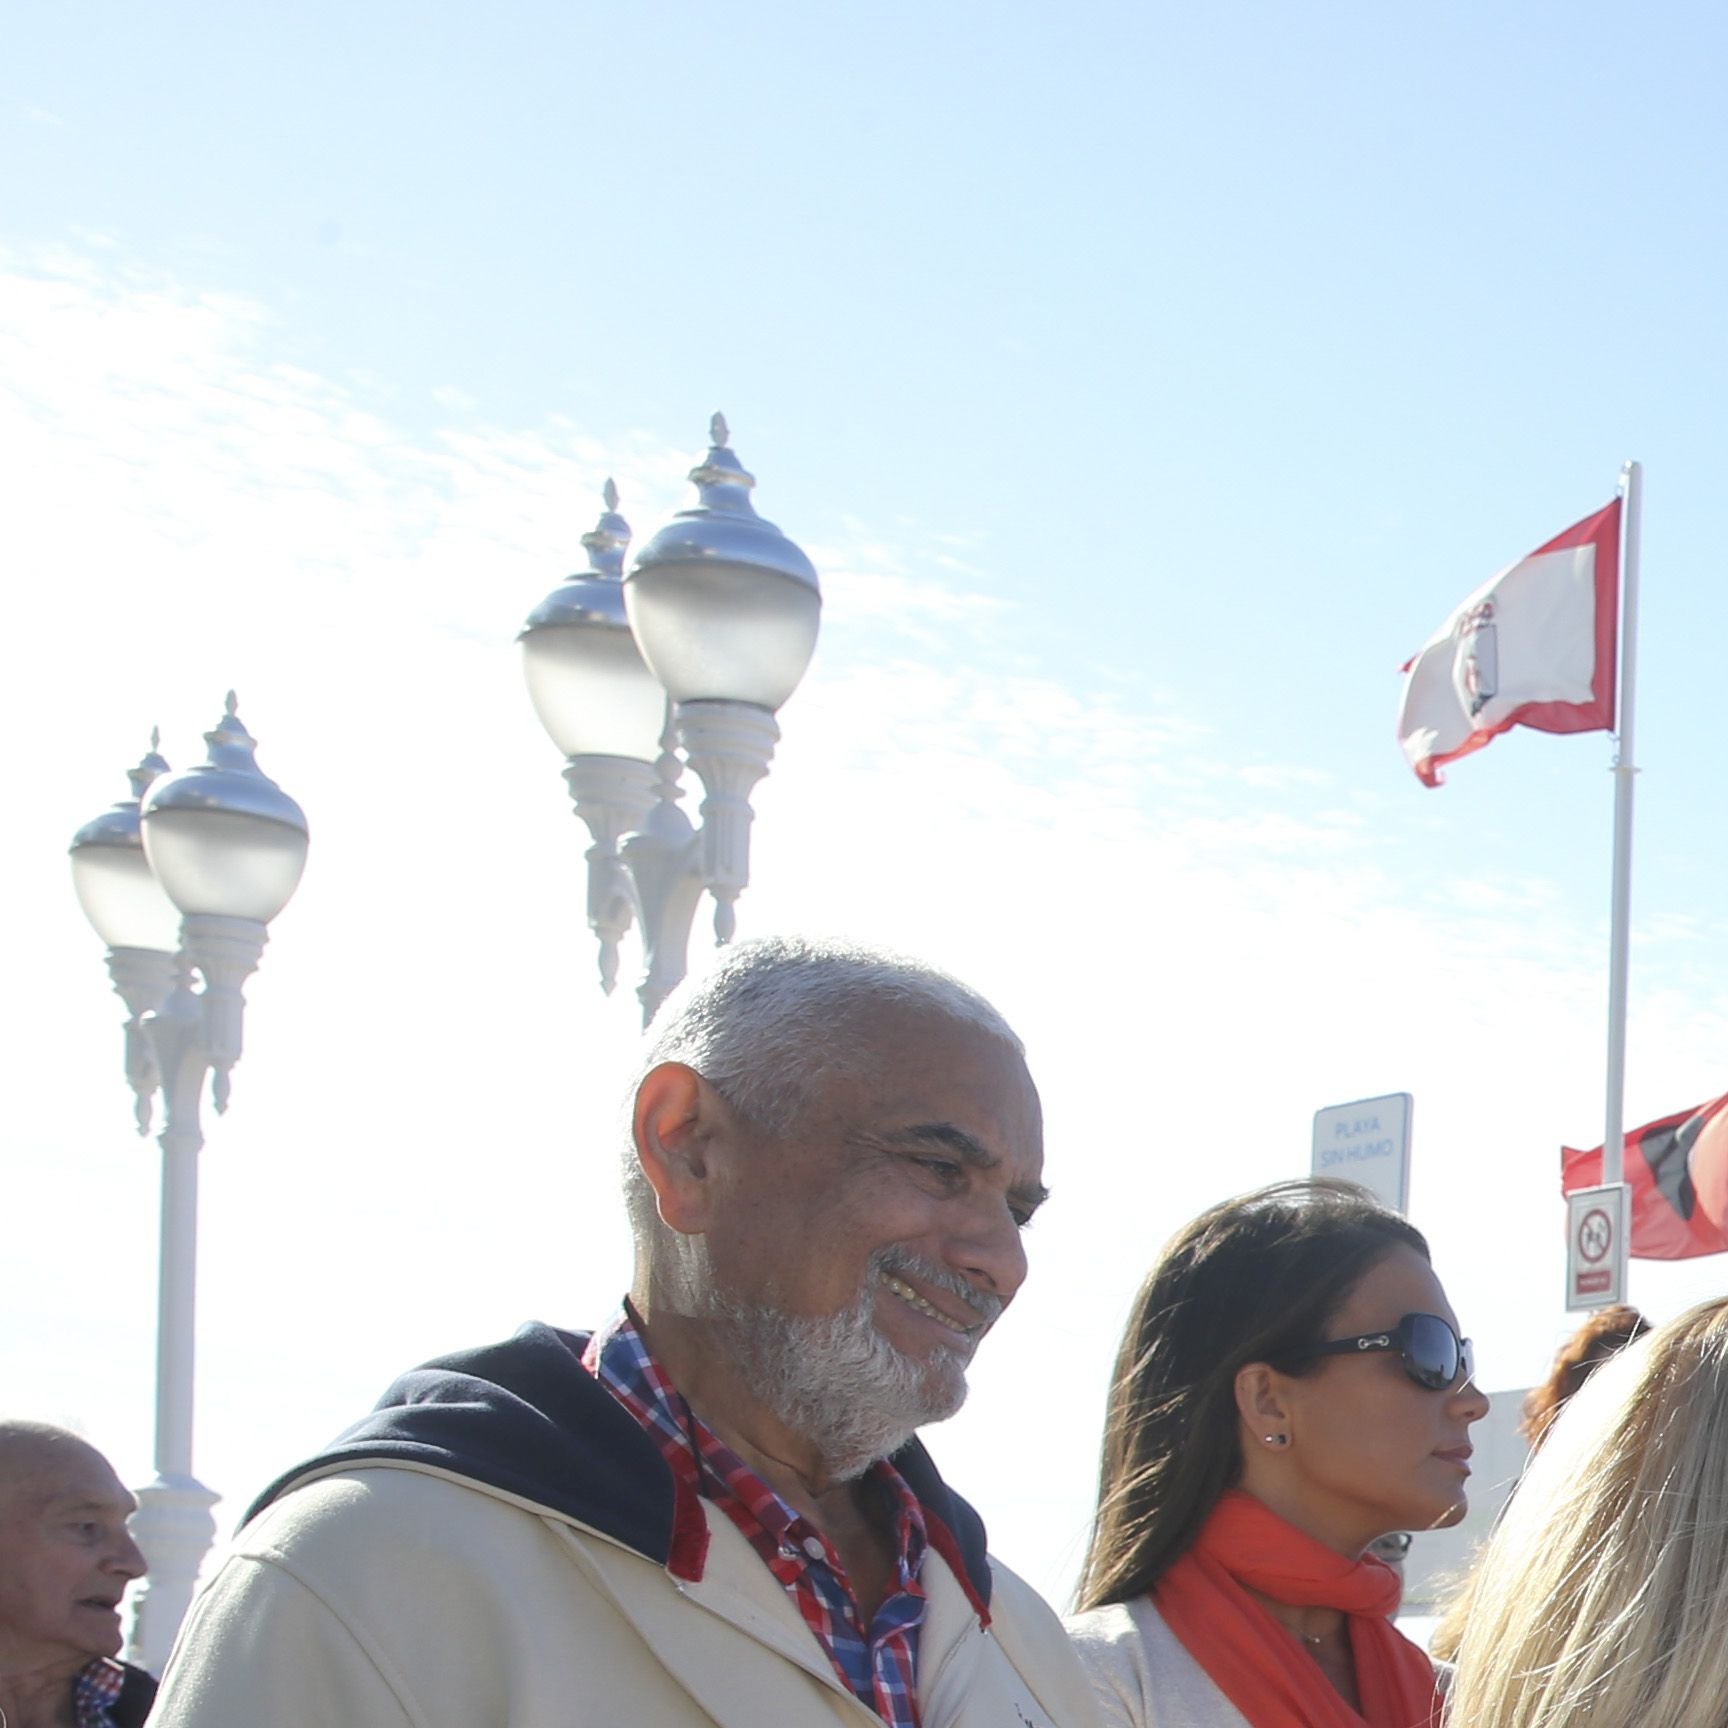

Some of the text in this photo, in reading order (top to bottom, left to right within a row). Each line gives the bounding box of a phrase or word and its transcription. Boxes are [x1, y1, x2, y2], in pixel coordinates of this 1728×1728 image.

[1335, 1118, 1381, 1138] PLAYA
[1321, 1139, 1394, 1167] SIN HUMO
